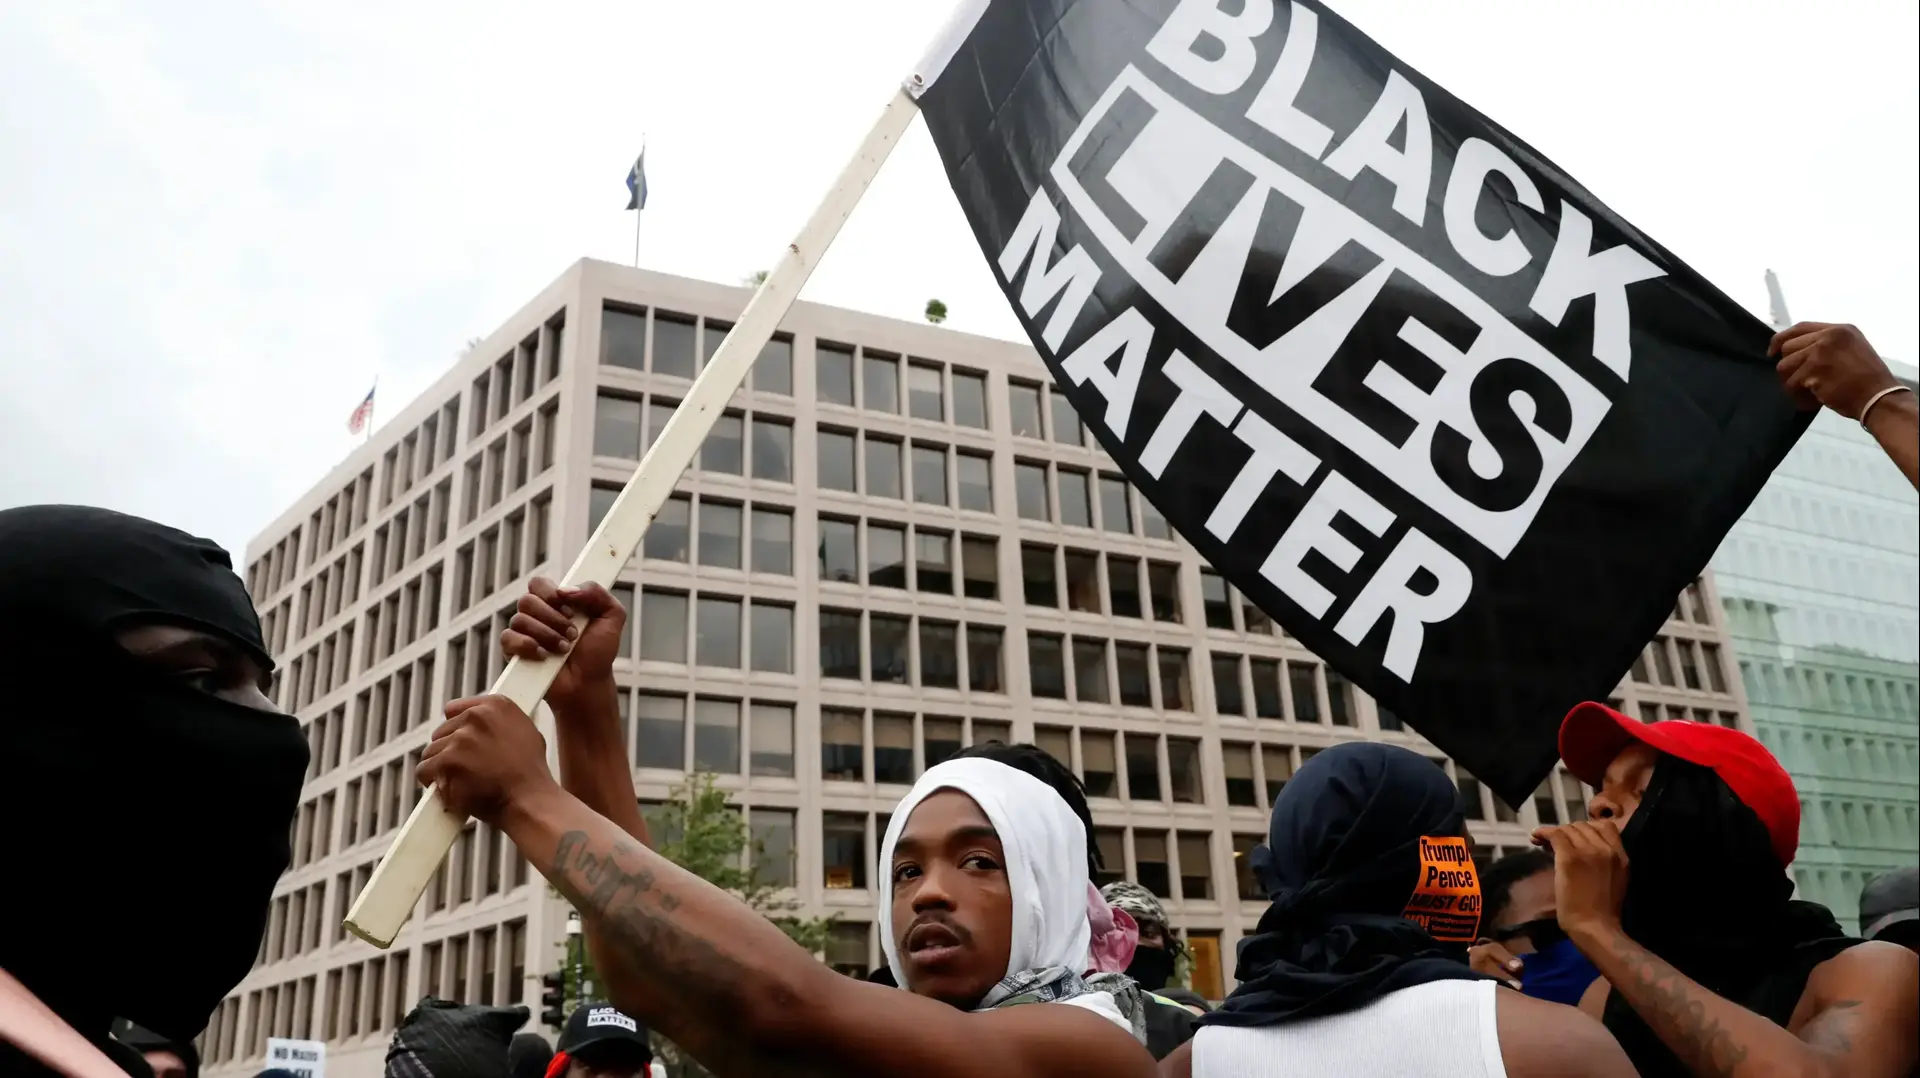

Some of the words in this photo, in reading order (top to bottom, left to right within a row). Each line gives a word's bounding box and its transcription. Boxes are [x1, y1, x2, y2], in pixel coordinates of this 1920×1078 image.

[1066, 85, 1573, 513] LIVES
[1144, 0, 1669, 383] BLACK
[998, 185, 1473, 684] MATTER
[1425, 866, 1474, 888] Pence
[1458, 894, 1480, 912] GO!
